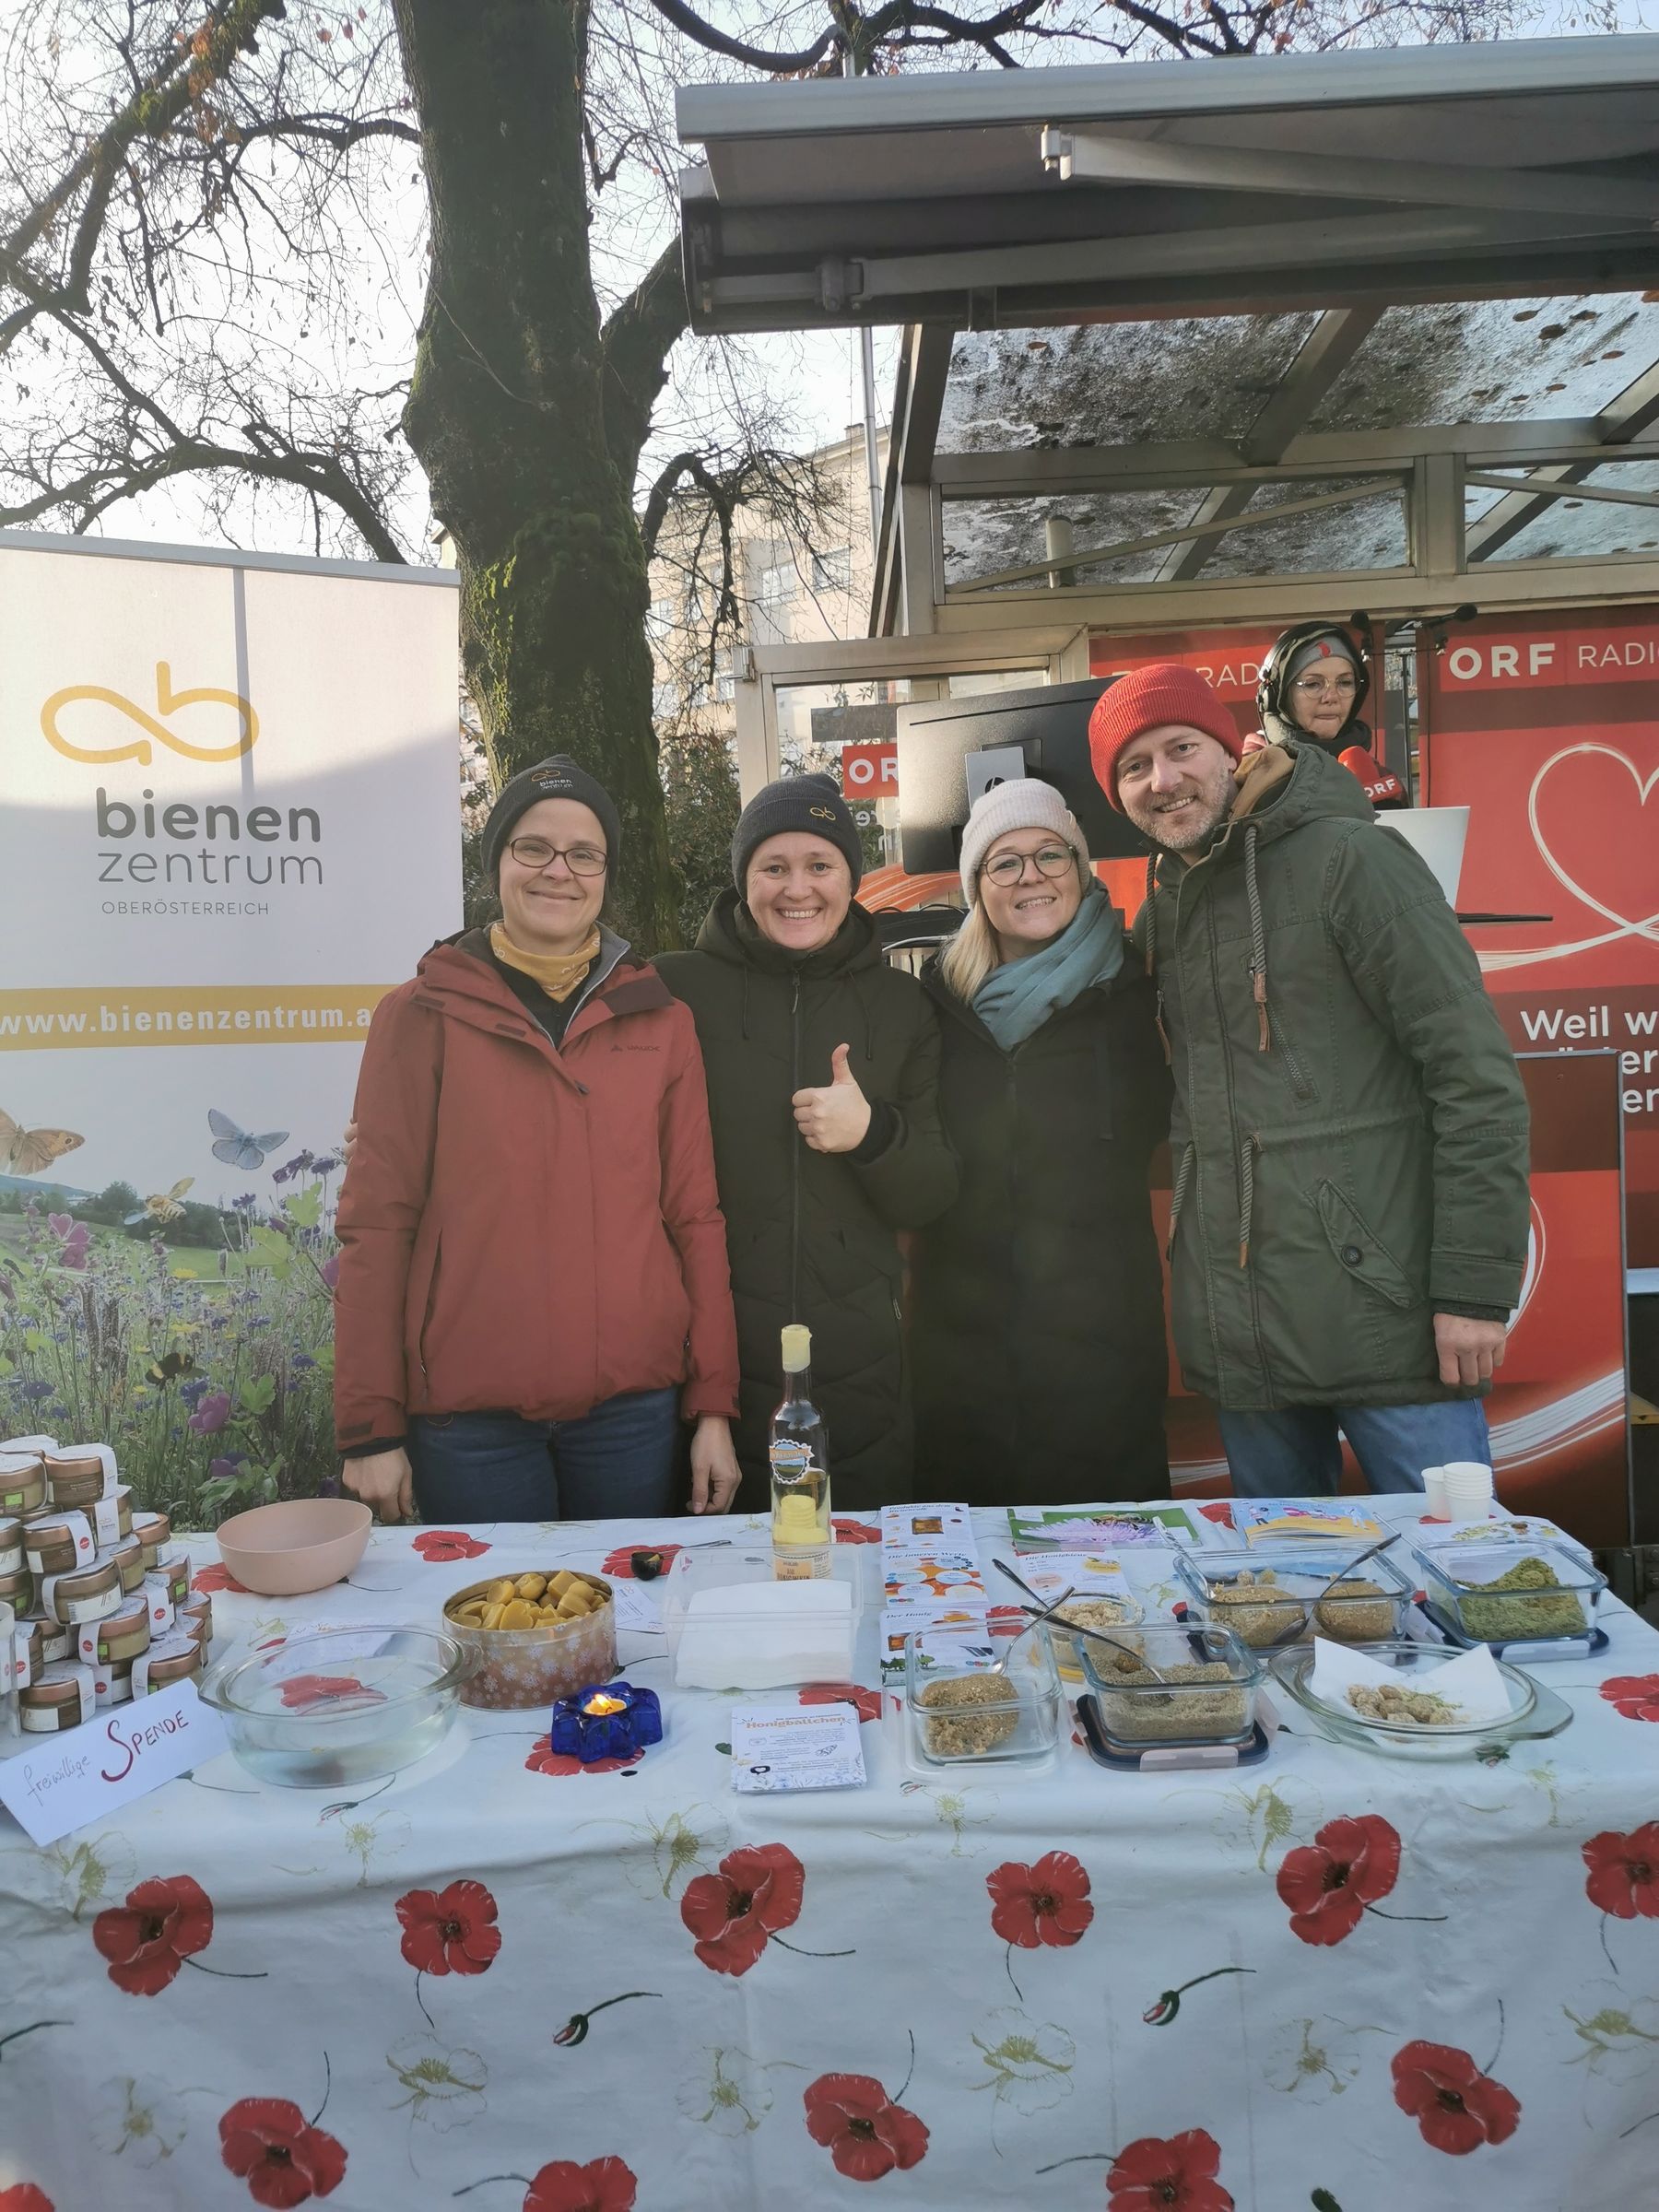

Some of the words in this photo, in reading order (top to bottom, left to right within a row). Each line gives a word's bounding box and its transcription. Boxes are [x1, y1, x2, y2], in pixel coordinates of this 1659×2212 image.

[1449, 642, 1556, 680] ORF
[1578, 641, 1659, 668] RADI
[1195, 662, 1260, 688] RAD
[848, 757, 900, 784] OR
[1363, 778, 1396, 798] ORF
[96, 785, 322, 842] bienen
[97, 847, 324, 885] zentrum
[100, 898, 269, 915] OBERÖSTERREICH
[0, 1005, 371, 1035] www.bienenzentrum.a
[1520, 1005, 1610, 1041] Weil
[1623, 1010, 1659, 1035] w
[1621, 1049, 1659, 1075] er
[1622, 1088, 1659, 1113] en
